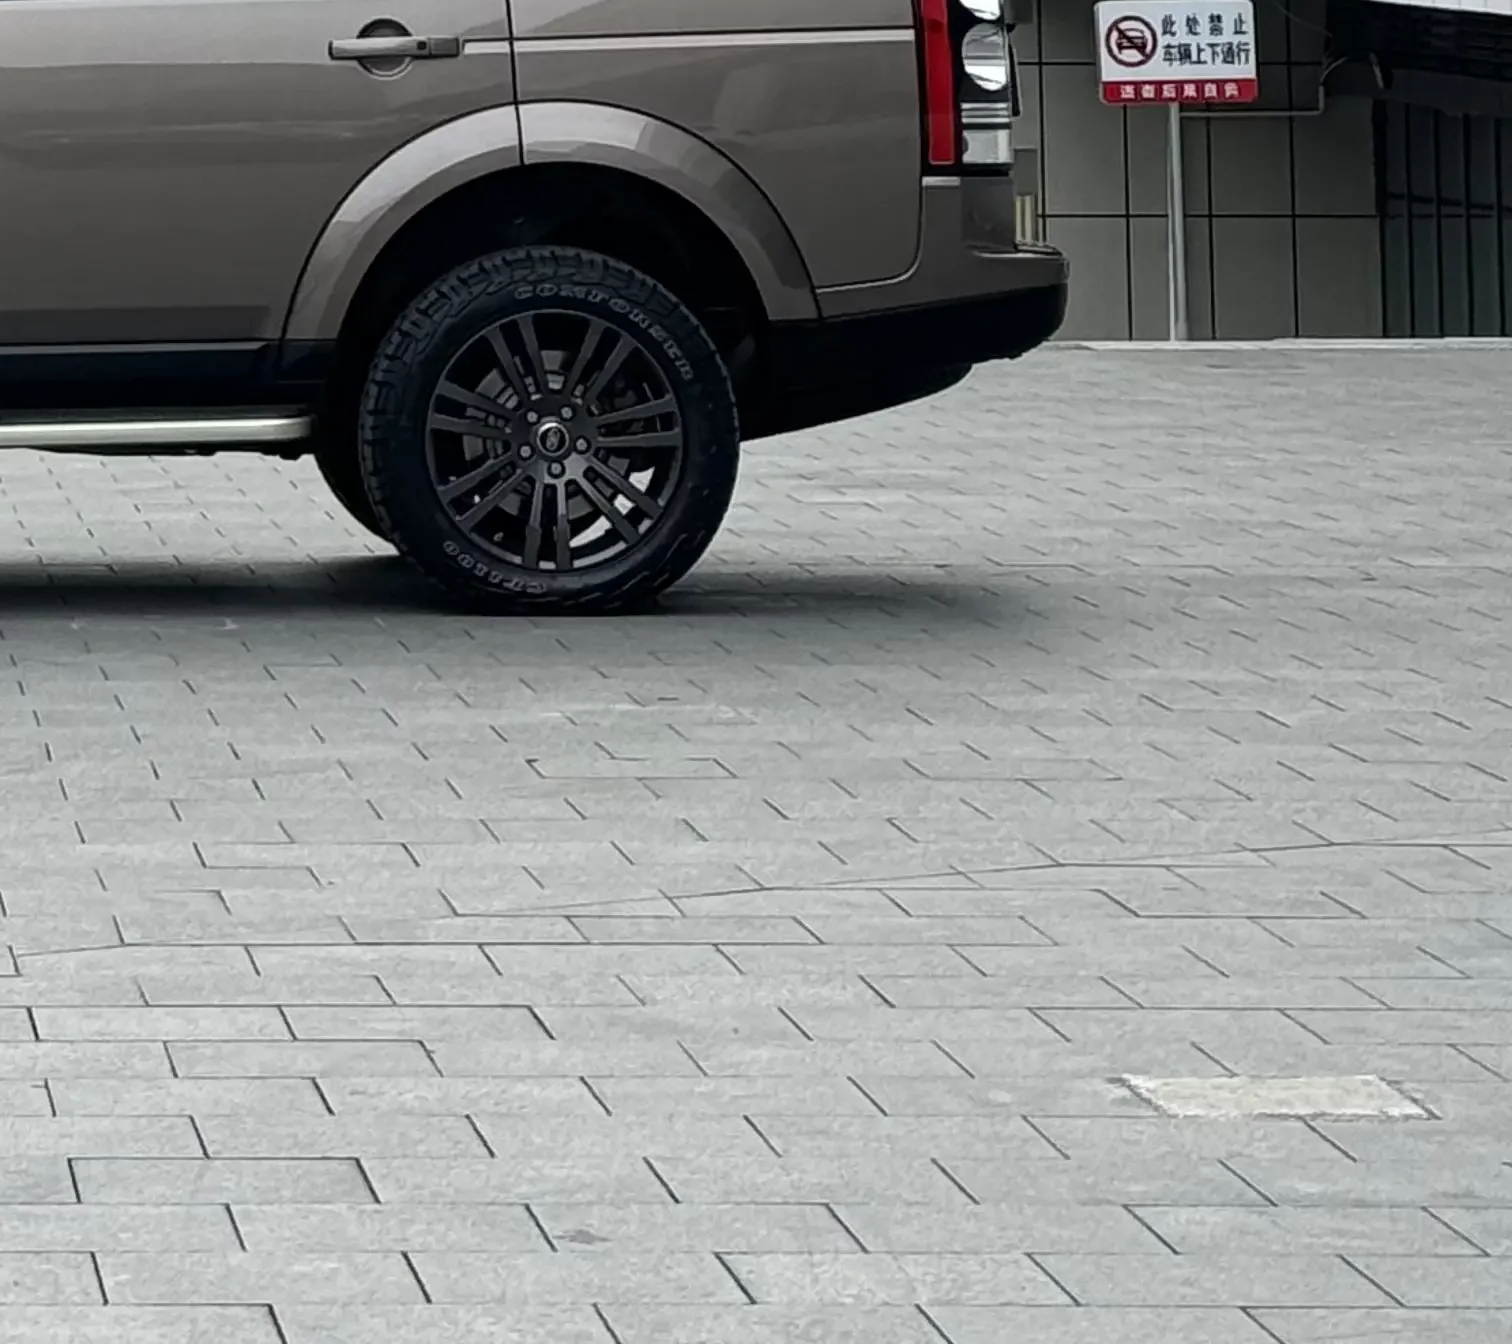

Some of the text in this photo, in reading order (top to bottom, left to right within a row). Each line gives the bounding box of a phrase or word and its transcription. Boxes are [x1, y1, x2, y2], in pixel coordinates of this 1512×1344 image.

[1161, 13, 1249, 37] 此处禁止
[1162, 41, 1251, 67] 车辆上下通行
